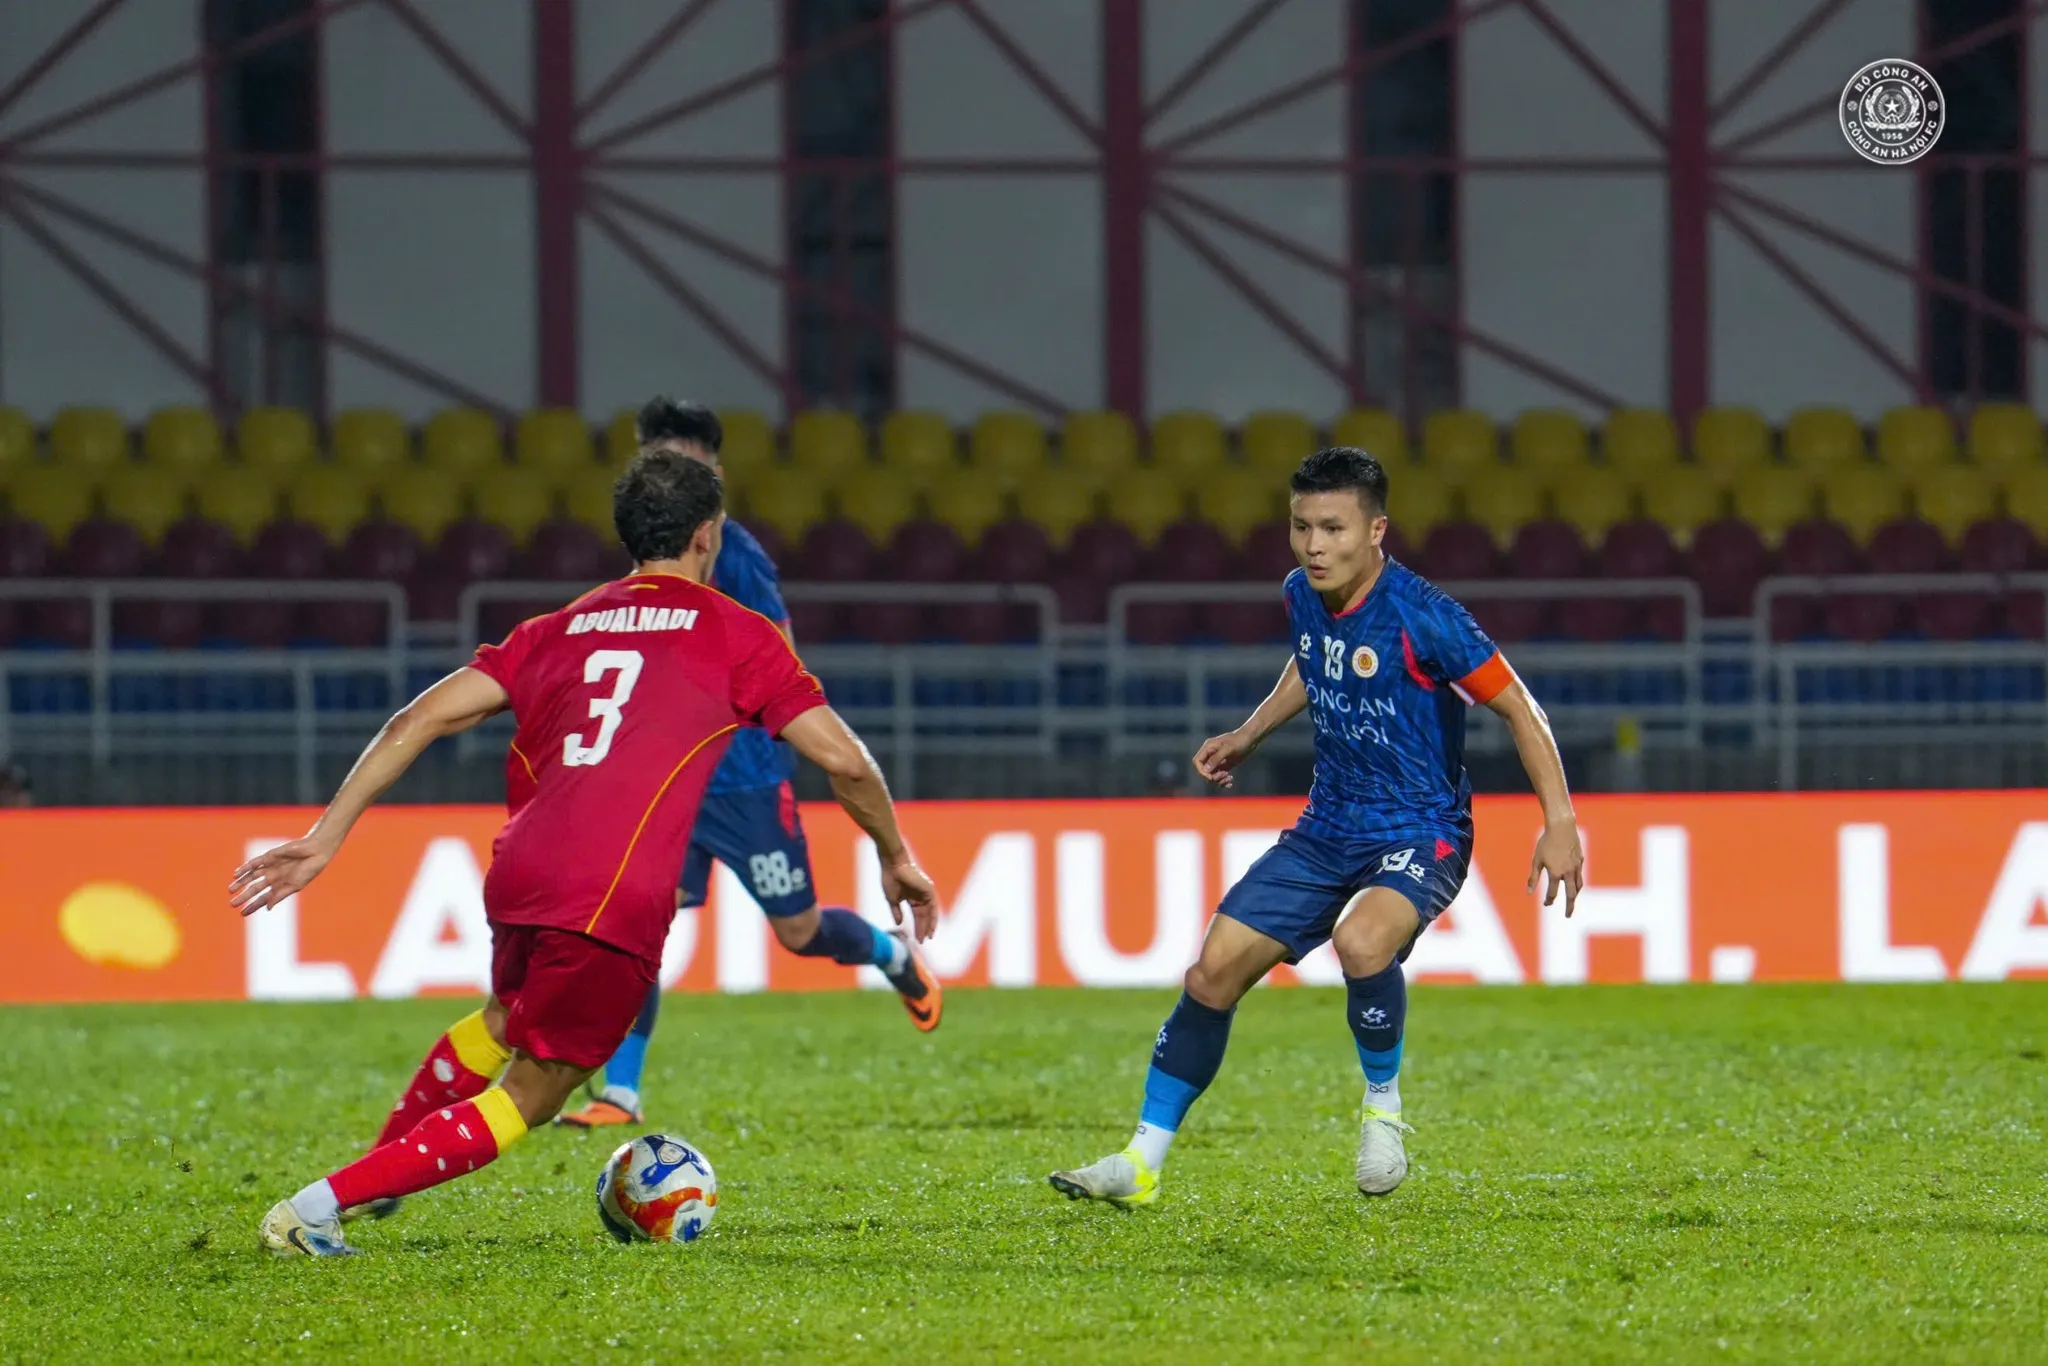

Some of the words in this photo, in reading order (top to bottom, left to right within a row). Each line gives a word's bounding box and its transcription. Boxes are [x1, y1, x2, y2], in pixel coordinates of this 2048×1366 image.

[565, 606, 699, 635] ABUALNADI
[1324, 635, 1346, 681] 19
[562, 650, 645, 767] 3
[1305, 677, 1351, 713] ÔNG
[1359, 697, 1397, 717] AN
[1376, 848, 1416, 875] 19
[245, 836, 769, 1000] LAI
